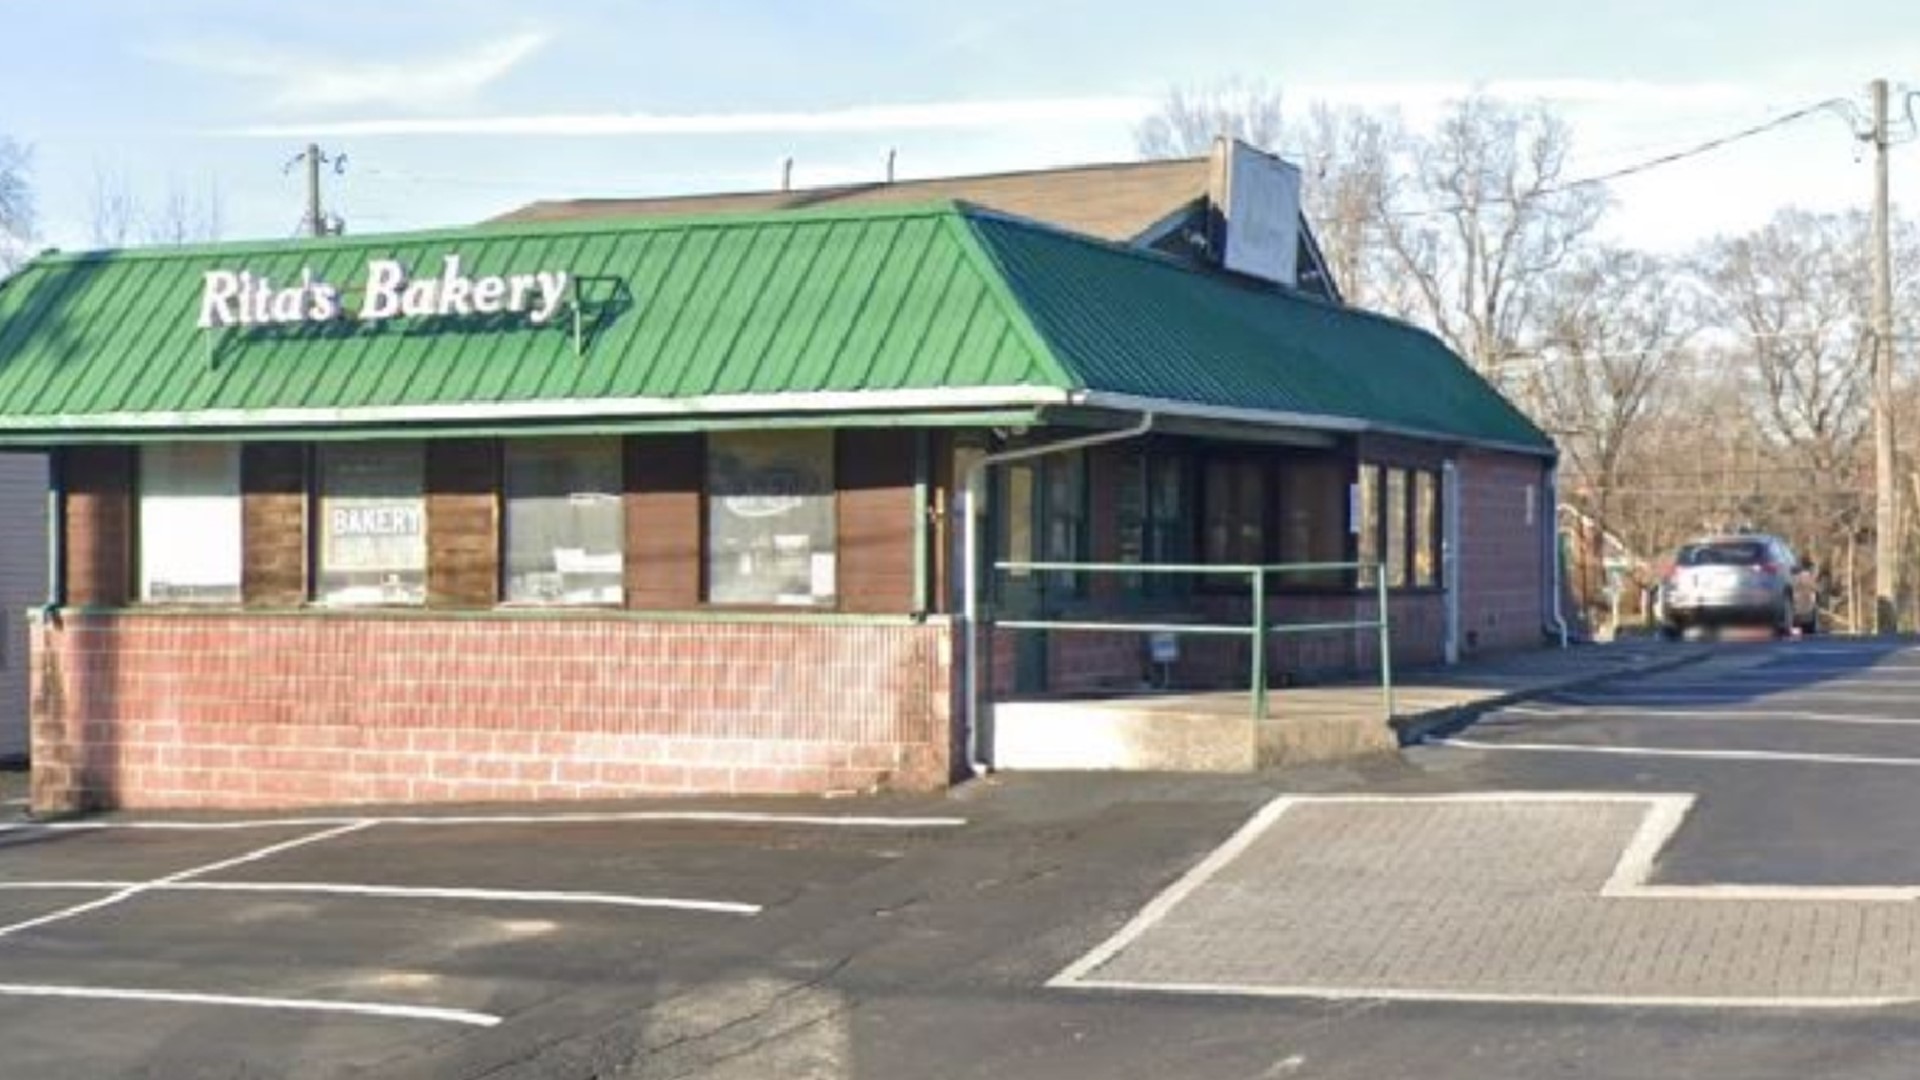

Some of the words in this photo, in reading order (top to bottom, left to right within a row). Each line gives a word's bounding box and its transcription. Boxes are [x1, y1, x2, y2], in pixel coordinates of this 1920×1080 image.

[197, 267, 336, 327] Rita's
[358, 255, 567, 322] Bakery
[334, 509, 418, 533] BAKERY
